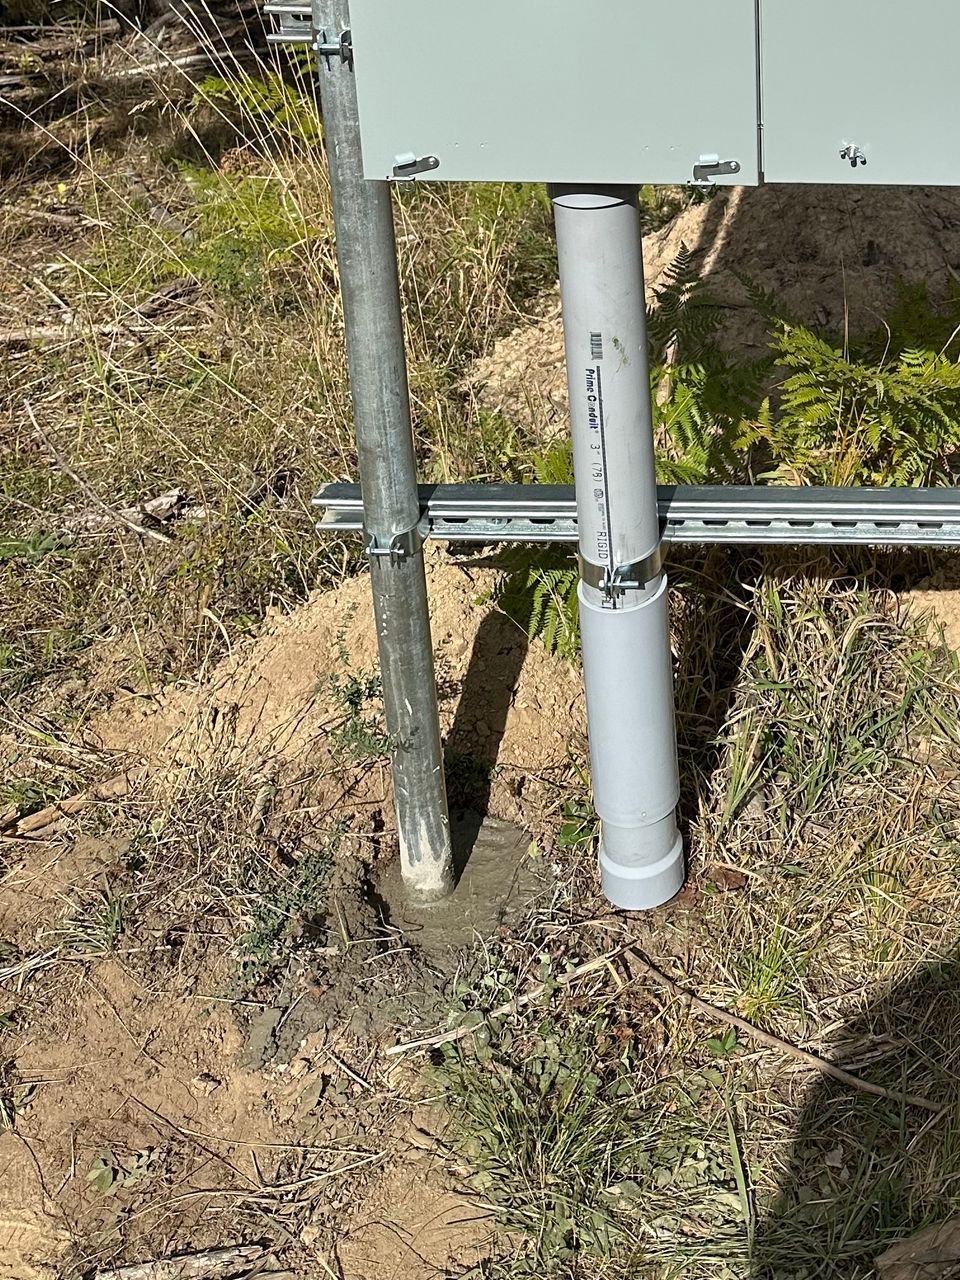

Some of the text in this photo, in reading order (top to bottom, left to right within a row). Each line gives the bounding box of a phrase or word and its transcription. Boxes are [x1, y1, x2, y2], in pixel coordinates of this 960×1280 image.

[585, 368, 596, 393] Prime
[592, 462, 603, 483] (78)
[597, 531, 609, 560] RIGID
